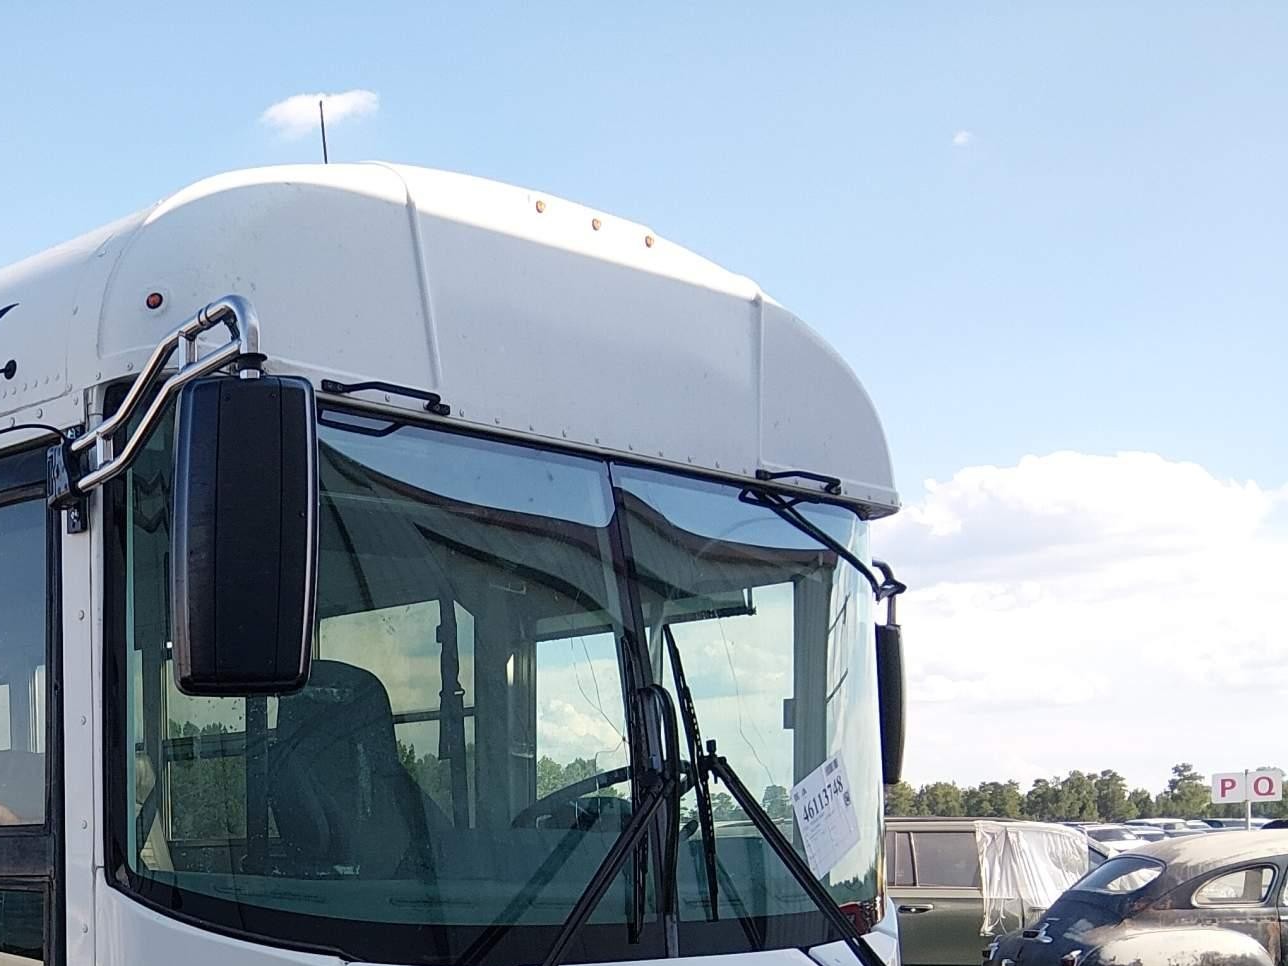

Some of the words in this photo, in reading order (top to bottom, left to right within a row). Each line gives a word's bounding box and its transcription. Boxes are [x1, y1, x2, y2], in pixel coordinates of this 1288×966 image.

[1220, 778, 1237, 798] P
[1253, 776, 1276, 796] Q
[803, 775, 844, 822] 46113748
